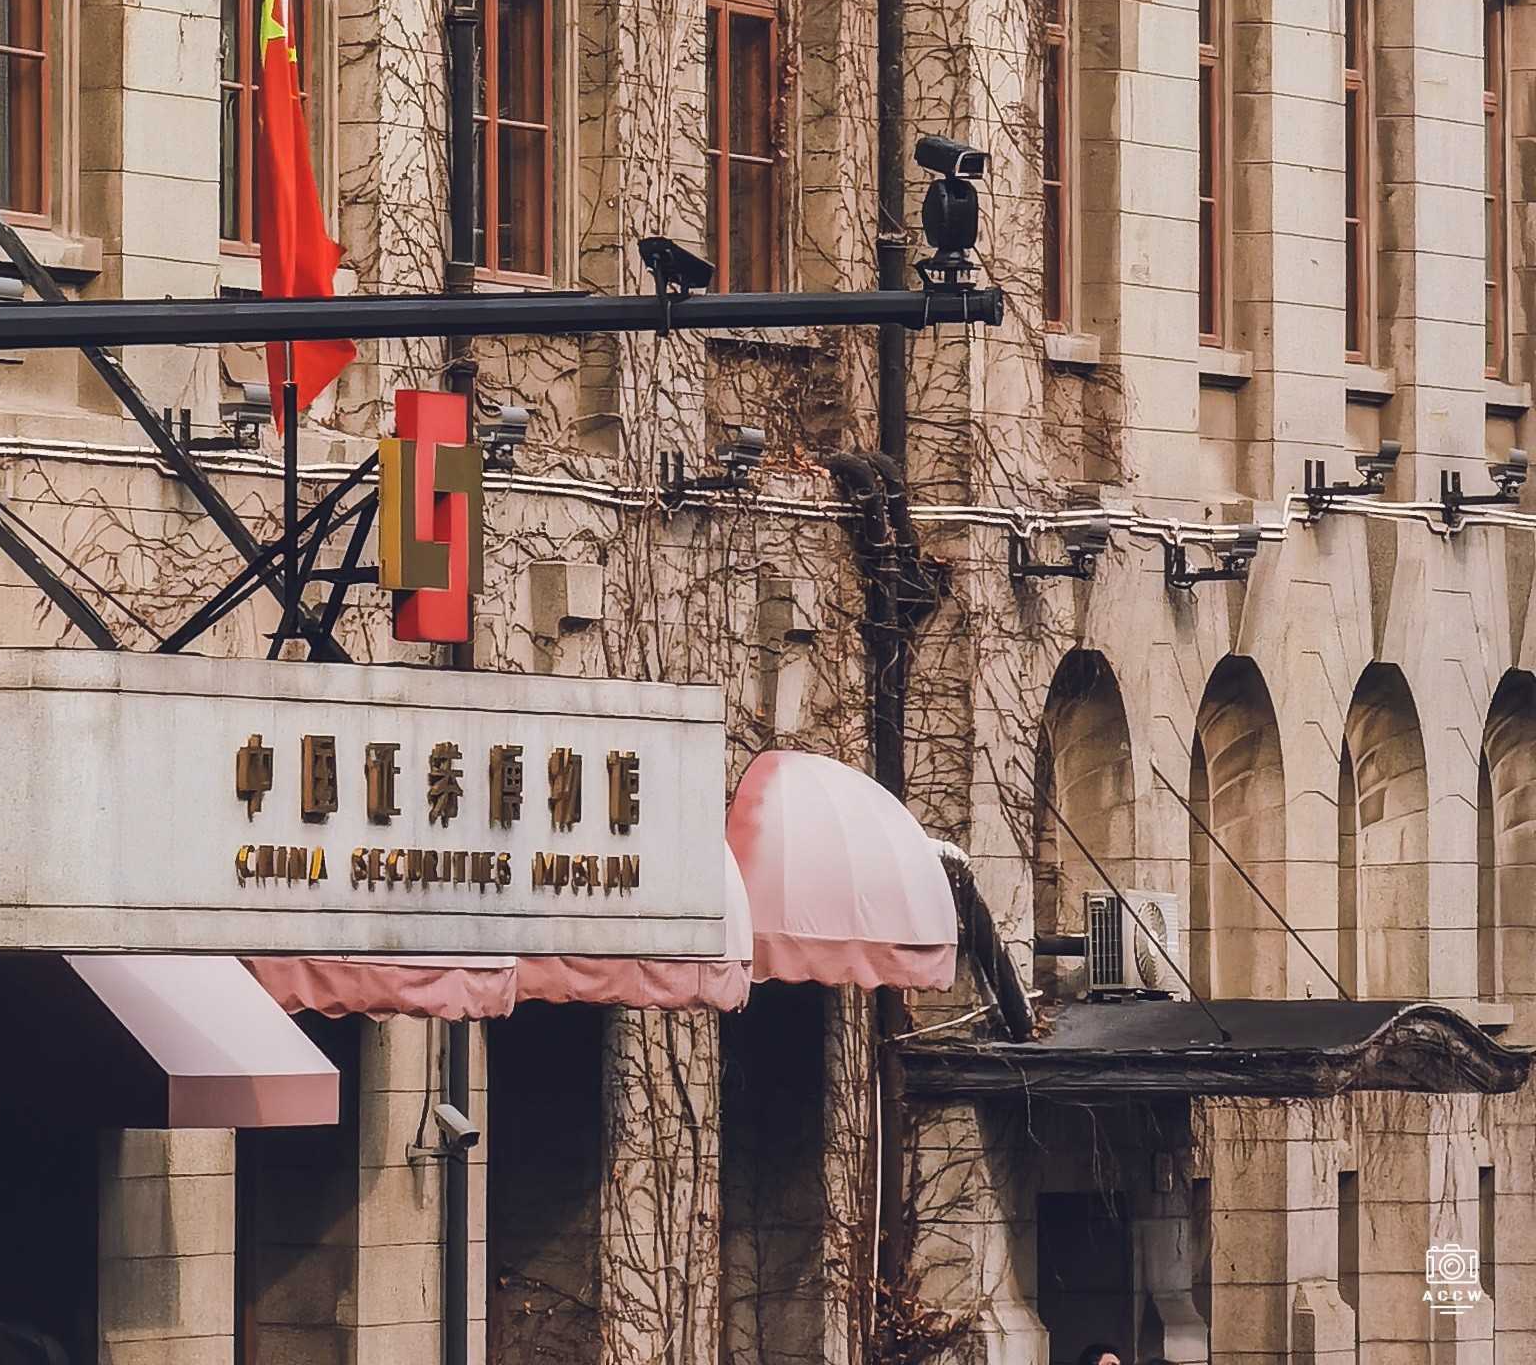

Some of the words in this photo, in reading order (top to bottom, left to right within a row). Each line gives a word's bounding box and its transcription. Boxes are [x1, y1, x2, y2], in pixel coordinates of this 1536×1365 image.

[235, 845, 328, 886] CHINA
[351, 847, 511, 889] SECURITIES
[531, 852, 640, 893] MUSEUM
